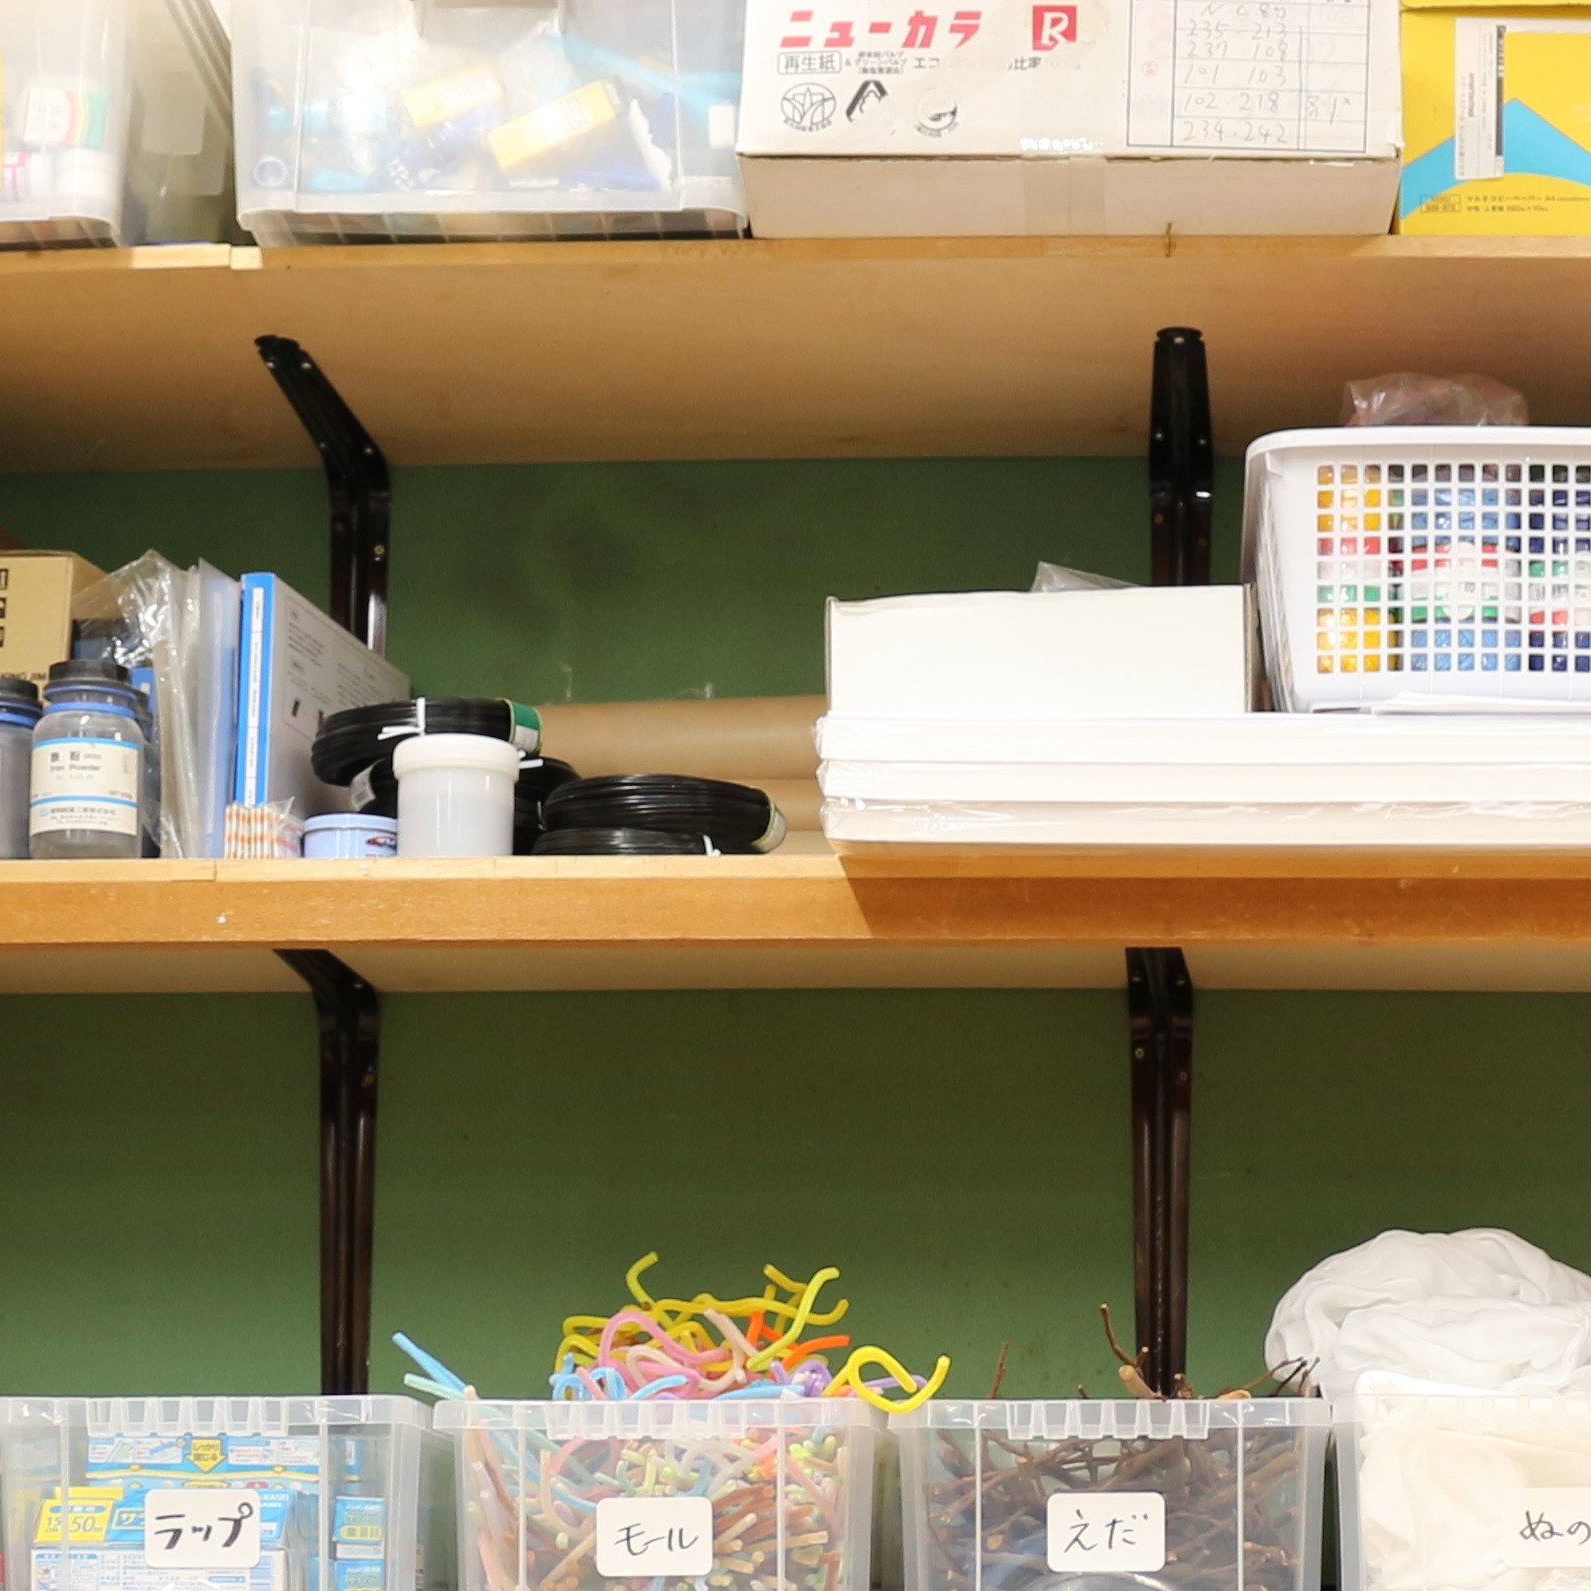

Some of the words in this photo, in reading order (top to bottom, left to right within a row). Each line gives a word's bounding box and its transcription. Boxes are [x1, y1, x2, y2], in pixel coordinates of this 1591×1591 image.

[779, 10, 982, 49] ニューカラ
[784, 54, 836, 71] 再生紙
[153, 1501, 255, 1550] ラップ
[614, 1522, 699, 1557] モール
[1063, 1508, 1150, 1554] えだ
